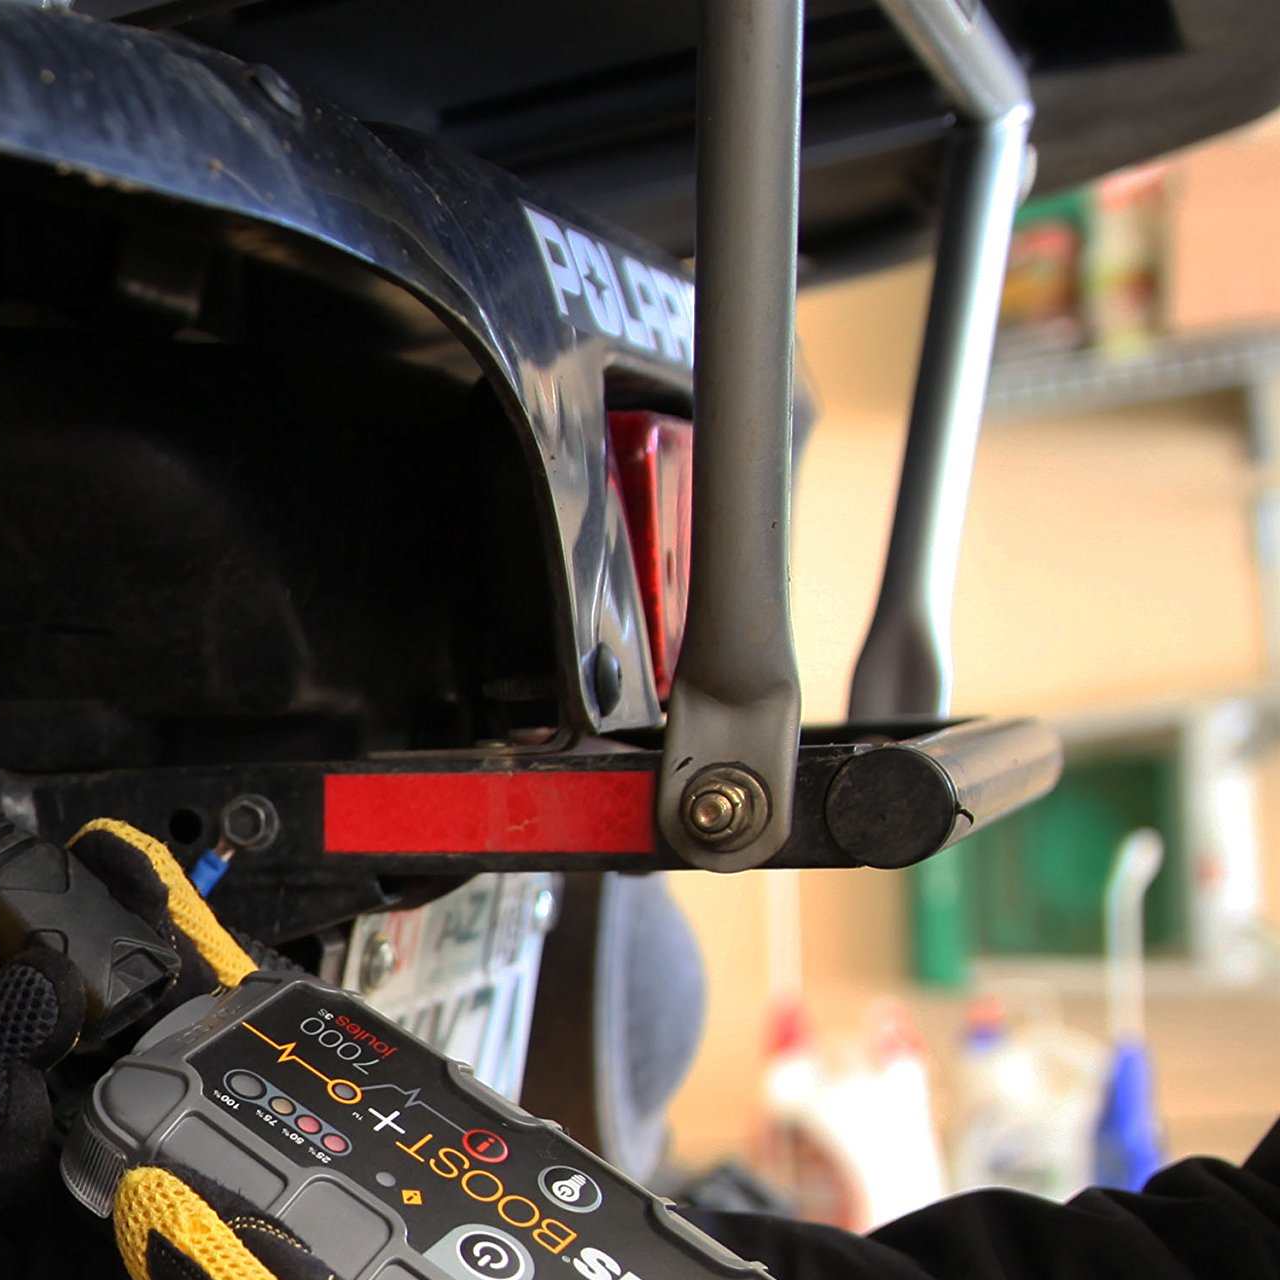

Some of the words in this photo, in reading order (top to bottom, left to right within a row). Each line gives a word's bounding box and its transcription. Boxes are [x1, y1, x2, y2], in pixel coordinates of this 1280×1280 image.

[522, 206, 695, 368] POLARI
[300, 1016, 380, 1075] 7000
[335, 1015, 398, 1058] joules
[213, 1090, 240, 1110] 100%
[255, 1109, 278, 1126] 75%
[281, 1128, 305, 1145] 50%
[308, 1147, 331, 1164] 25%
